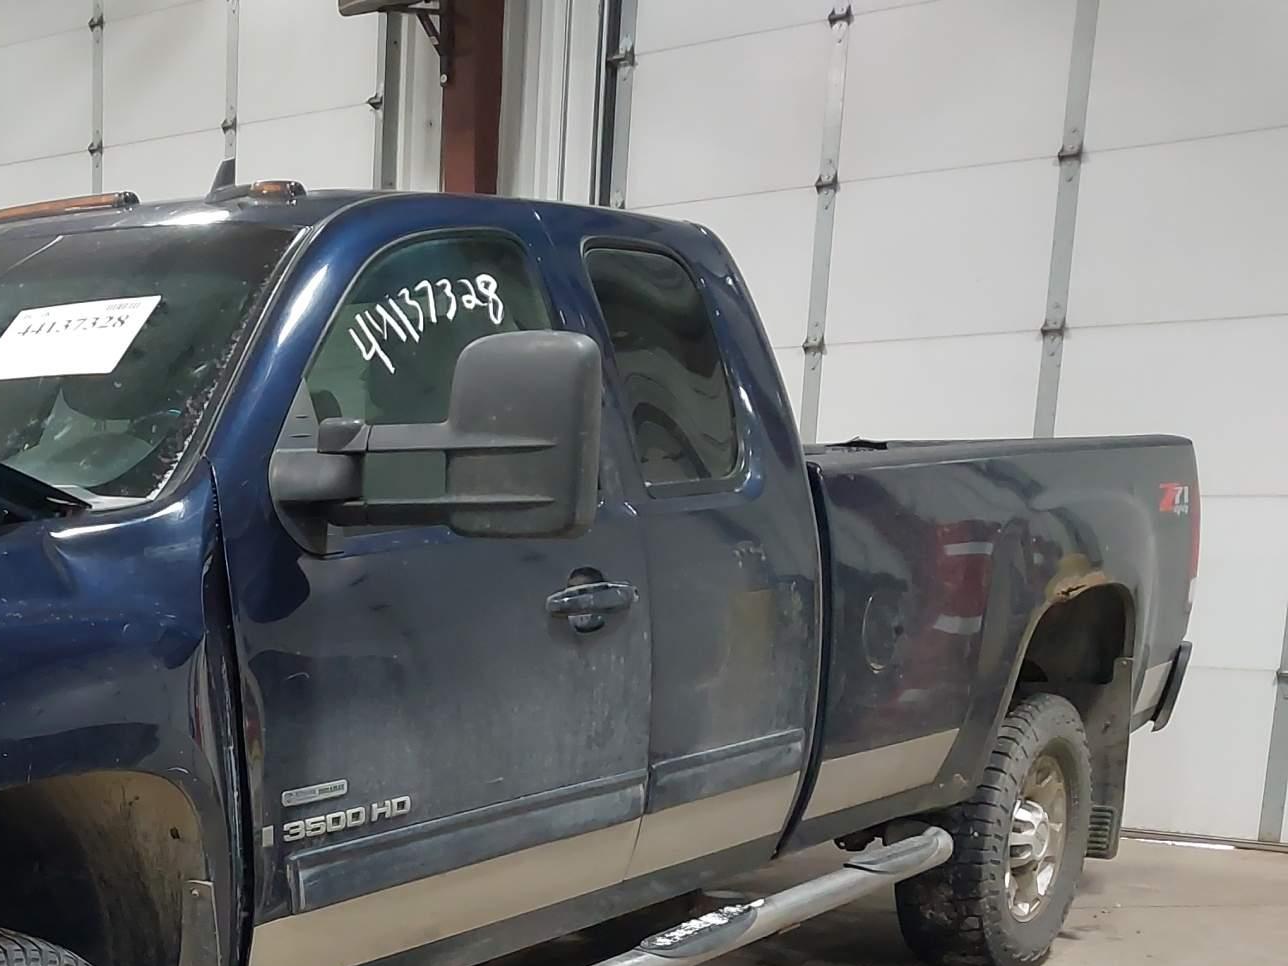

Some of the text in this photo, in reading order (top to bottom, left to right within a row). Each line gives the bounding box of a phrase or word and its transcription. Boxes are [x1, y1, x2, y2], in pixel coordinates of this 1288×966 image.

[17, 314, 130, 337] 44137328
[348, 273, 504, 375] 44137328
[1159, 483, 1189, 512] Z71
[283, 795, 411, 842] 3500 HD
